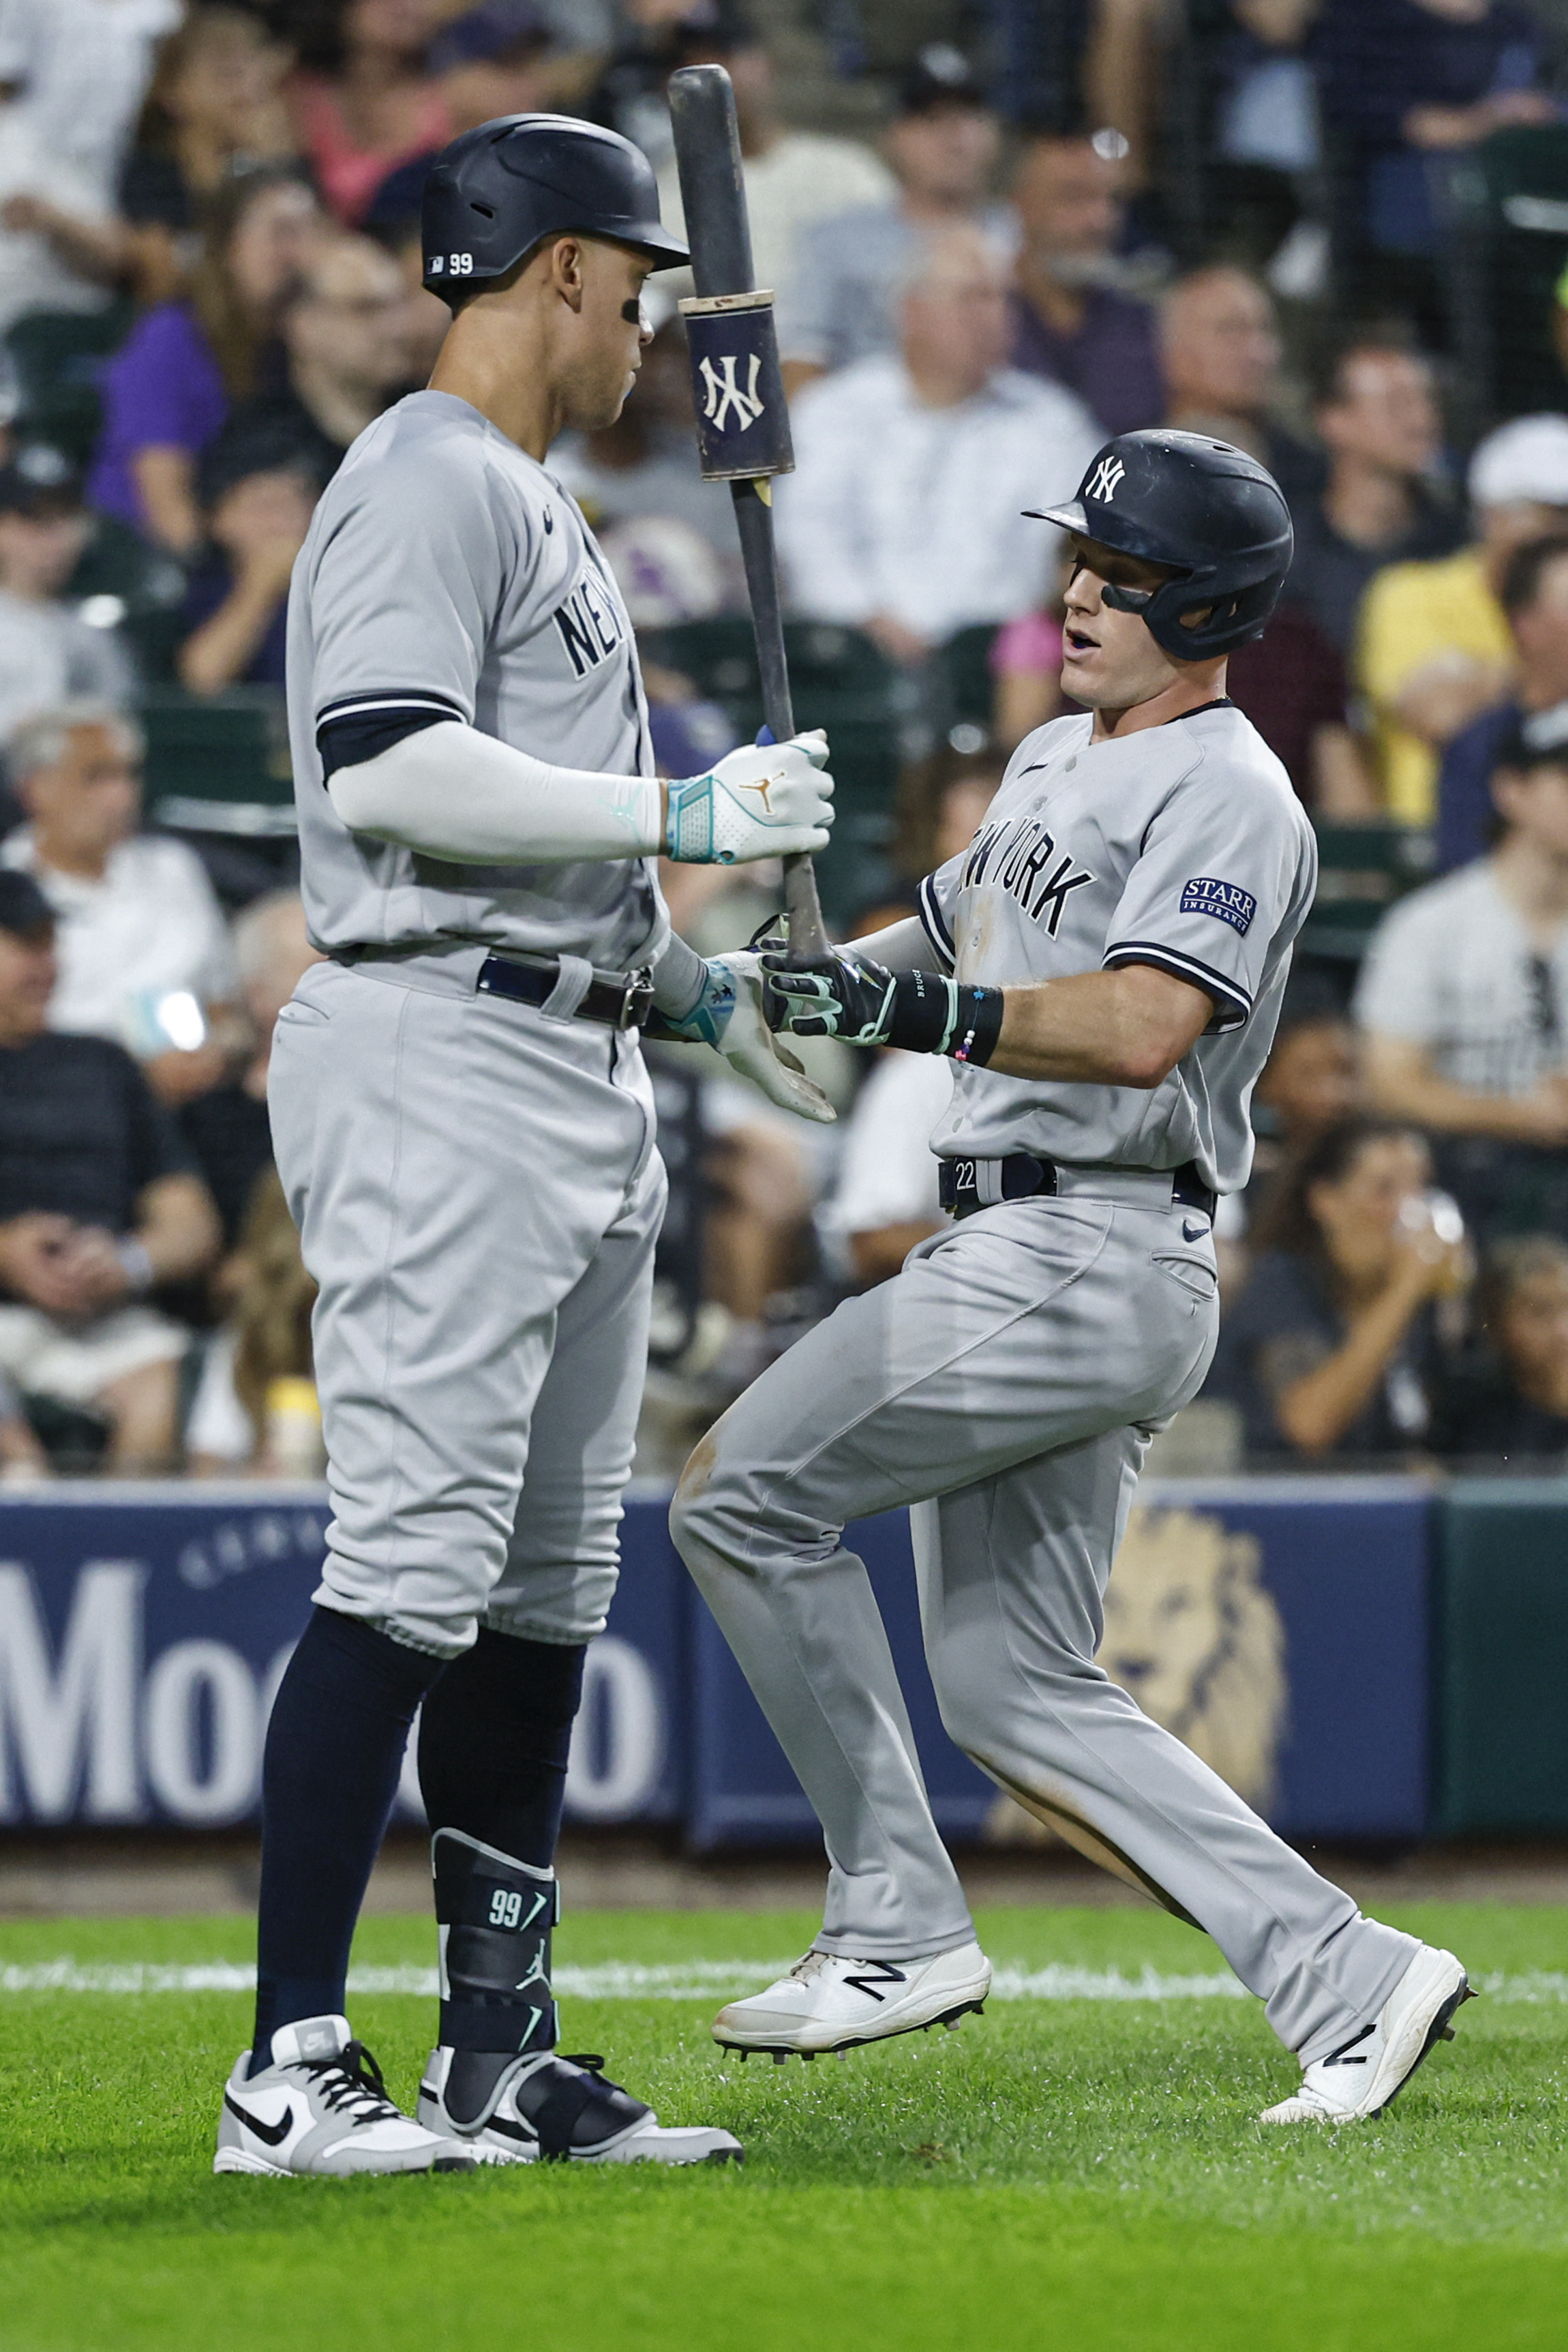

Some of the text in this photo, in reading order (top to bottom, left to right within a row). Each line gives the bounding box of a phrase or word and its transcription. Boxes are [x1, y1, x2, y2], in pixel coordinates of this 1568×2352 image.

[449, 252, 474, 276] 99
[552, 563, 625, 681] NE
[989, 816, 1098, 942] YORK
[1183, 901, 1247, 932] INSURANCE
[1186, 880, 1253, 920] STARR
[955, 1161, 976, 1191] 22
[489, 1888, 523, 1928] 99
